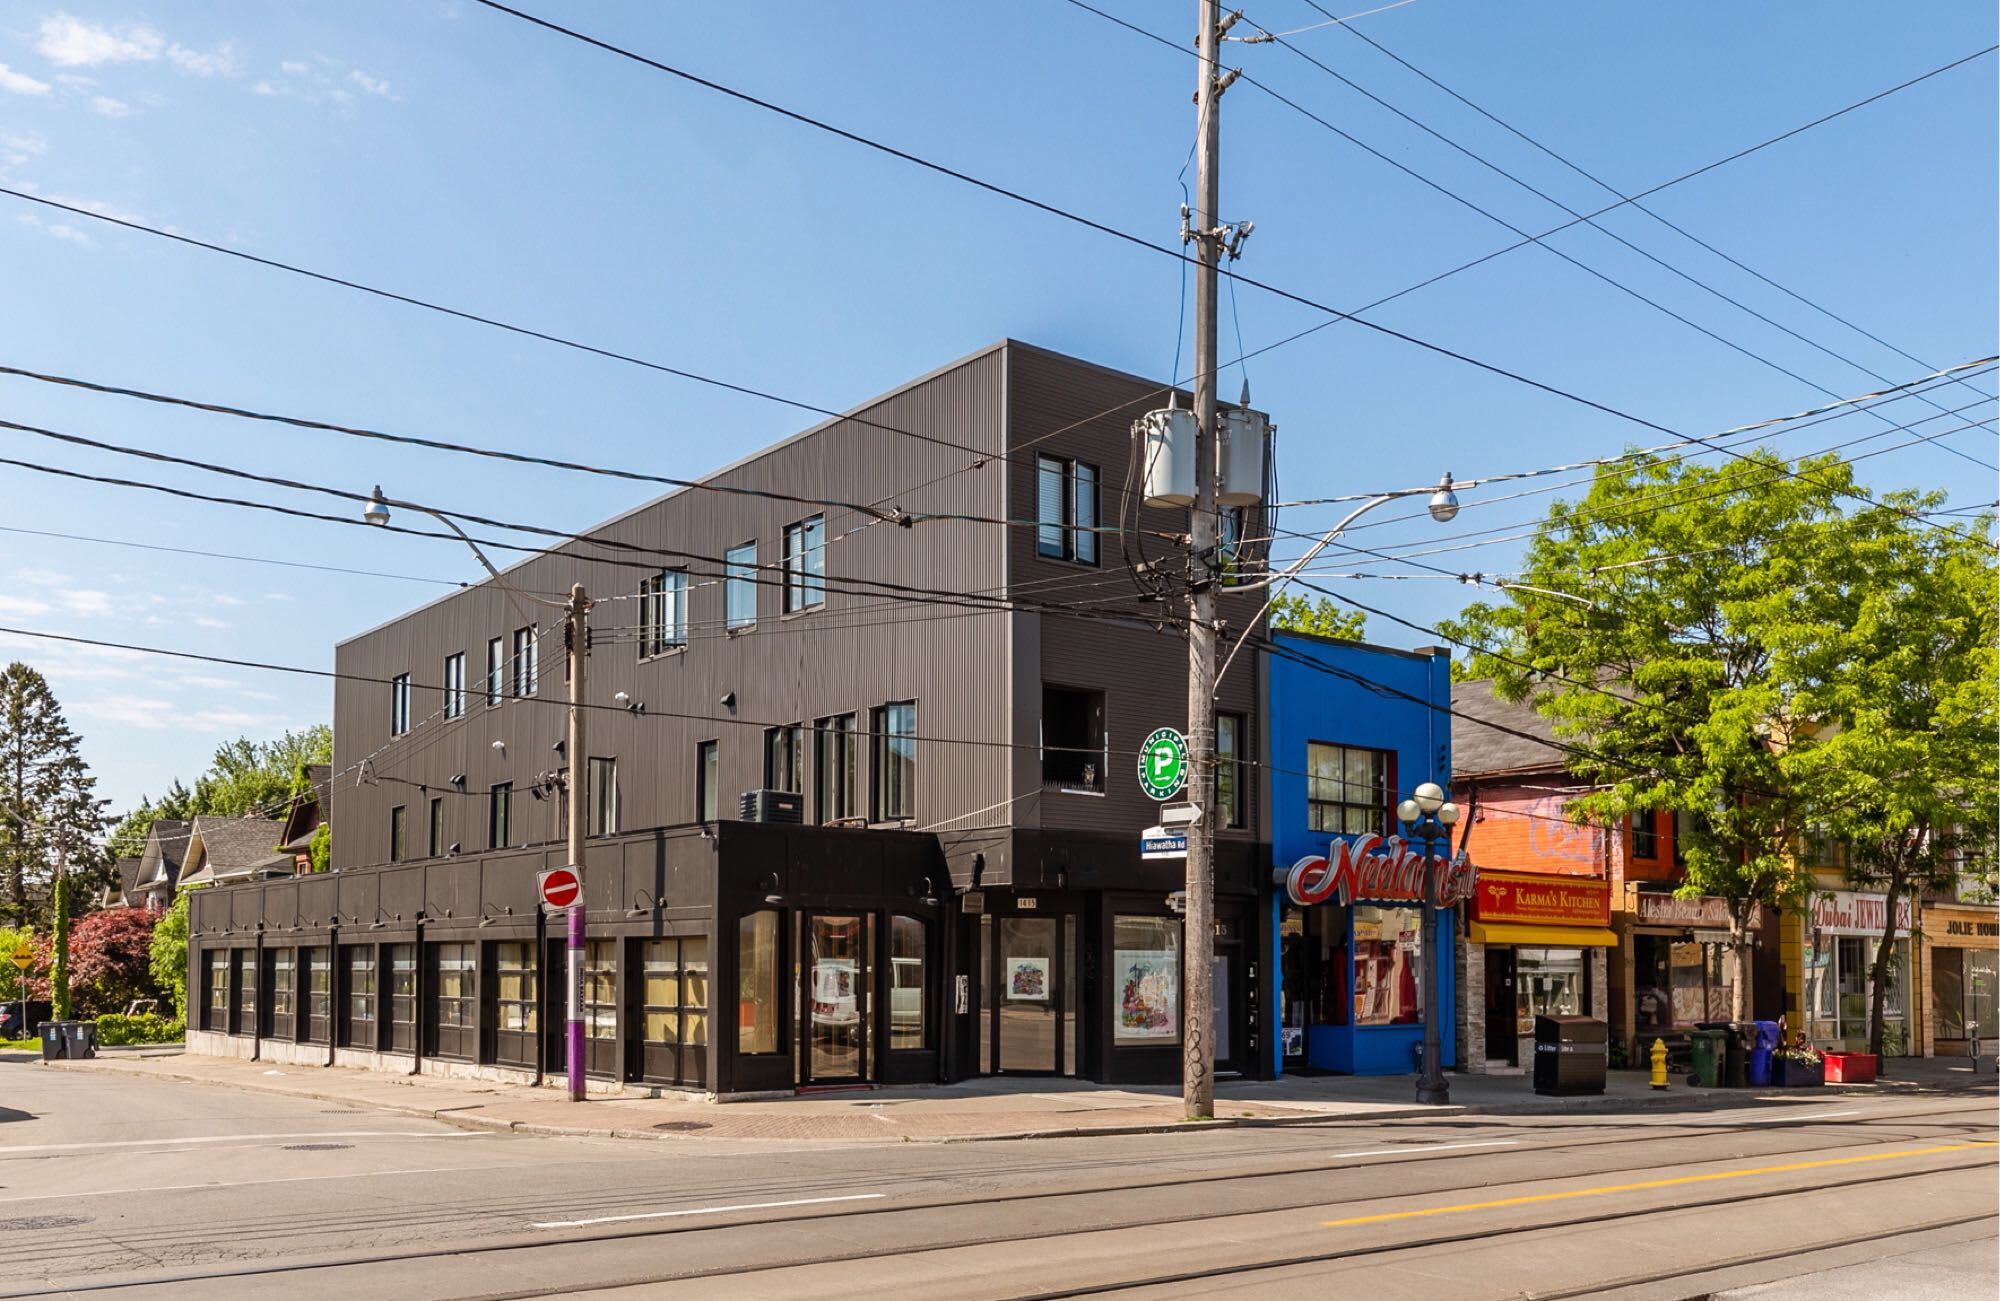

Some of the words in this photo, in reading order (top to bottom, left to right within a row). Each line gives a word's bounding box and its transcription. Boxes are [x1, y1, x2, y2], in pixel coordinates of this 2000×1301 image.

[1155, 747, 1173, 775] P
[1145, 840, 1176, 850] Hiawatha
[1177, 840, 1185, 849] Rd
[1560, 890, 1600, 908] KITCHEN
[1814, 899, 1851, 928] Dubai
[1855, 899, 1910, 930] JEWELRS
[1946, 920, 1973, 936] JOLIE
